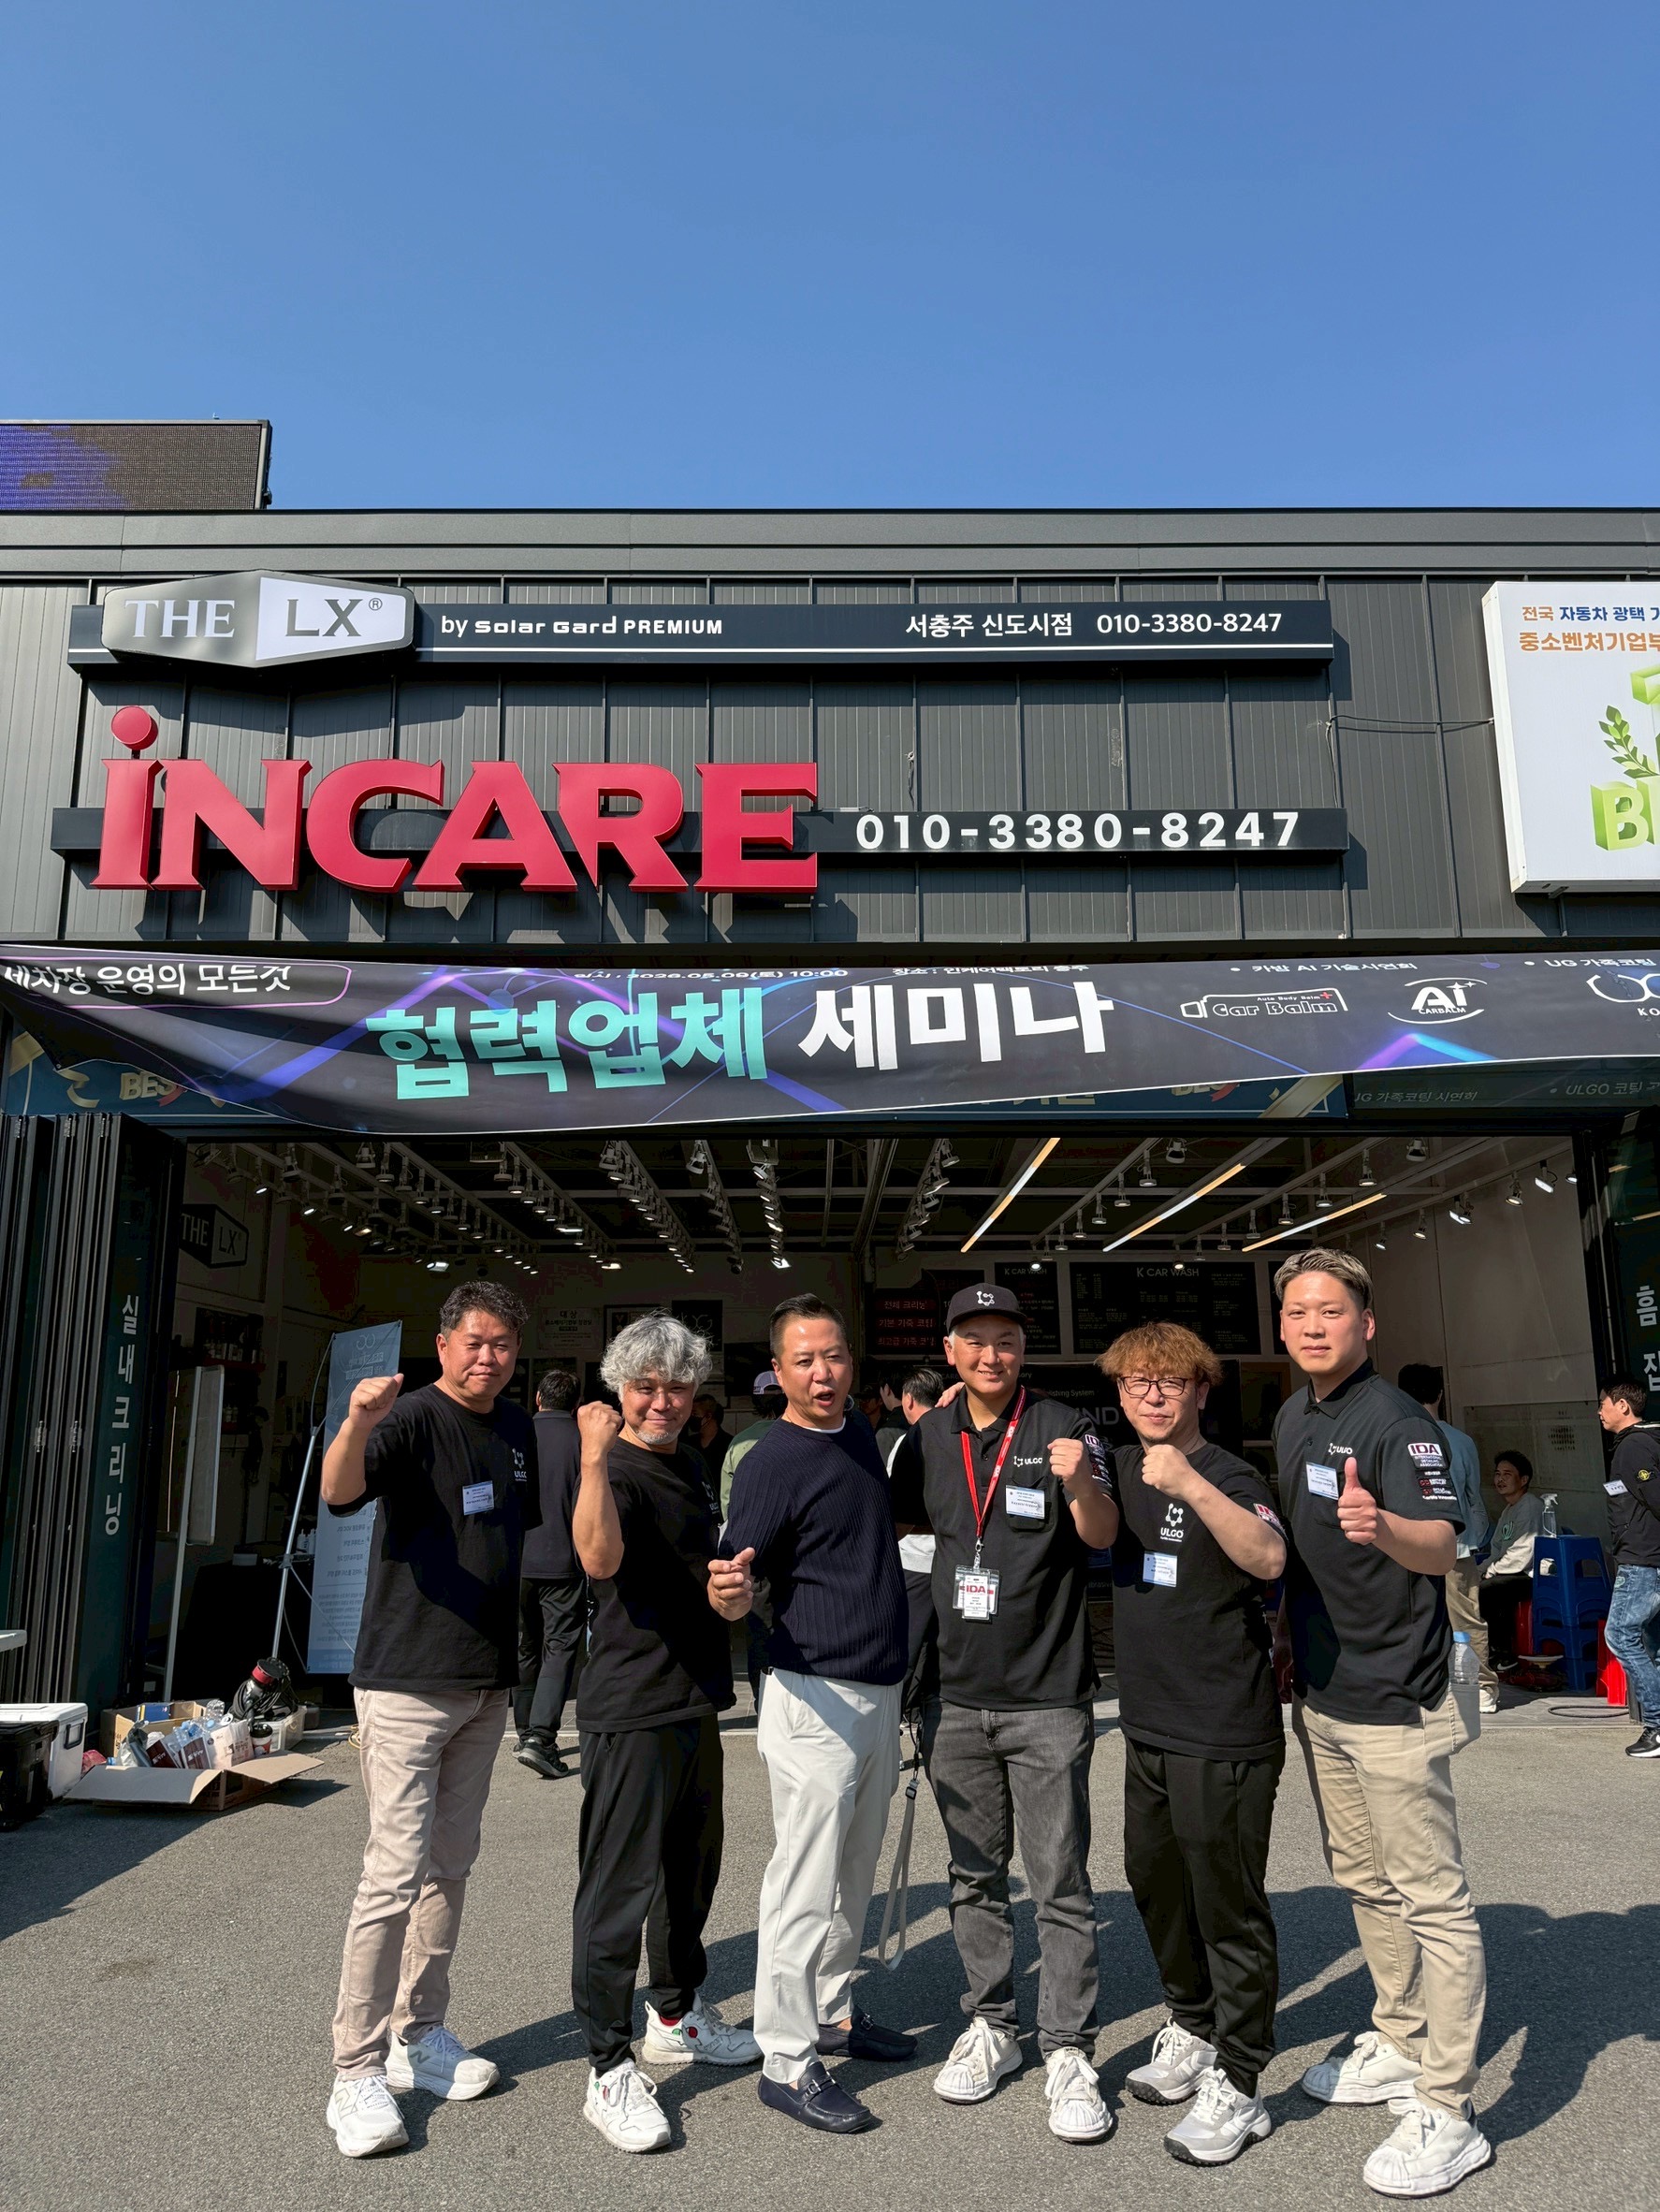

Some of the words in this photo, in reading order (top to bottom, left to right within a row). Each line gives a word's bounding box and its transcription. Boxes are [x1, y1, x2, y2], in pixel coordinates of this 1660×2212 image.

[124, 599, 236, 638] THE
[1522, 606, 1554, 621] 전국
[1559, 606, 1608, 621] 자동차
[1612, 606, 1645, 621] 광택
[441, 613, 468, 639] by
[474, 619, 546, 634] Solar
[553, 615, 618, 634] Gard
[623, 619, 723, 634] PREMIUM
[905, 612, 975, 639] 서충주
[981, 611, 1073, 639] 신도시점
[1097, 612, 1283, 635] 010-3380-8247
[855, 811, 1300, 851] 010-3380-8247
[1544, 959, 1578, 968] UG
[4, 965, 92, 995] 세차장
[96, 963, 185, 996] 운영의
[197, 964, 292, 993] 모든것
[789, 969, 849, 978] 10:00
[1213, 1003, 1260, 1017] Car
[1266, 1000, 1338, 1016] Balm
[1419, 1006, 1466, 1015] CARBALM
[366, 986, 767, 1100] 협력업체
[798, 981, 1114, 1071] 세미나
[1565, 1083, 1610, 1096] ULGO
[1613, 1081, 1644, 1095] 코팅
[181, 1212, 210, 1247] THE
[1136, 1267, 1144, 1278] K
[1146, 1268, 1169, 1277] CAR
[1169, 1267, 1200, 1277] WASH
[1410, 1444, 1440, 1455] IDA
[1024, 1457, 1043, 1465] ULGO
[1160, 1526, 1185, 1539] ULGO
[966, 1585, 986, 1594] IDA
